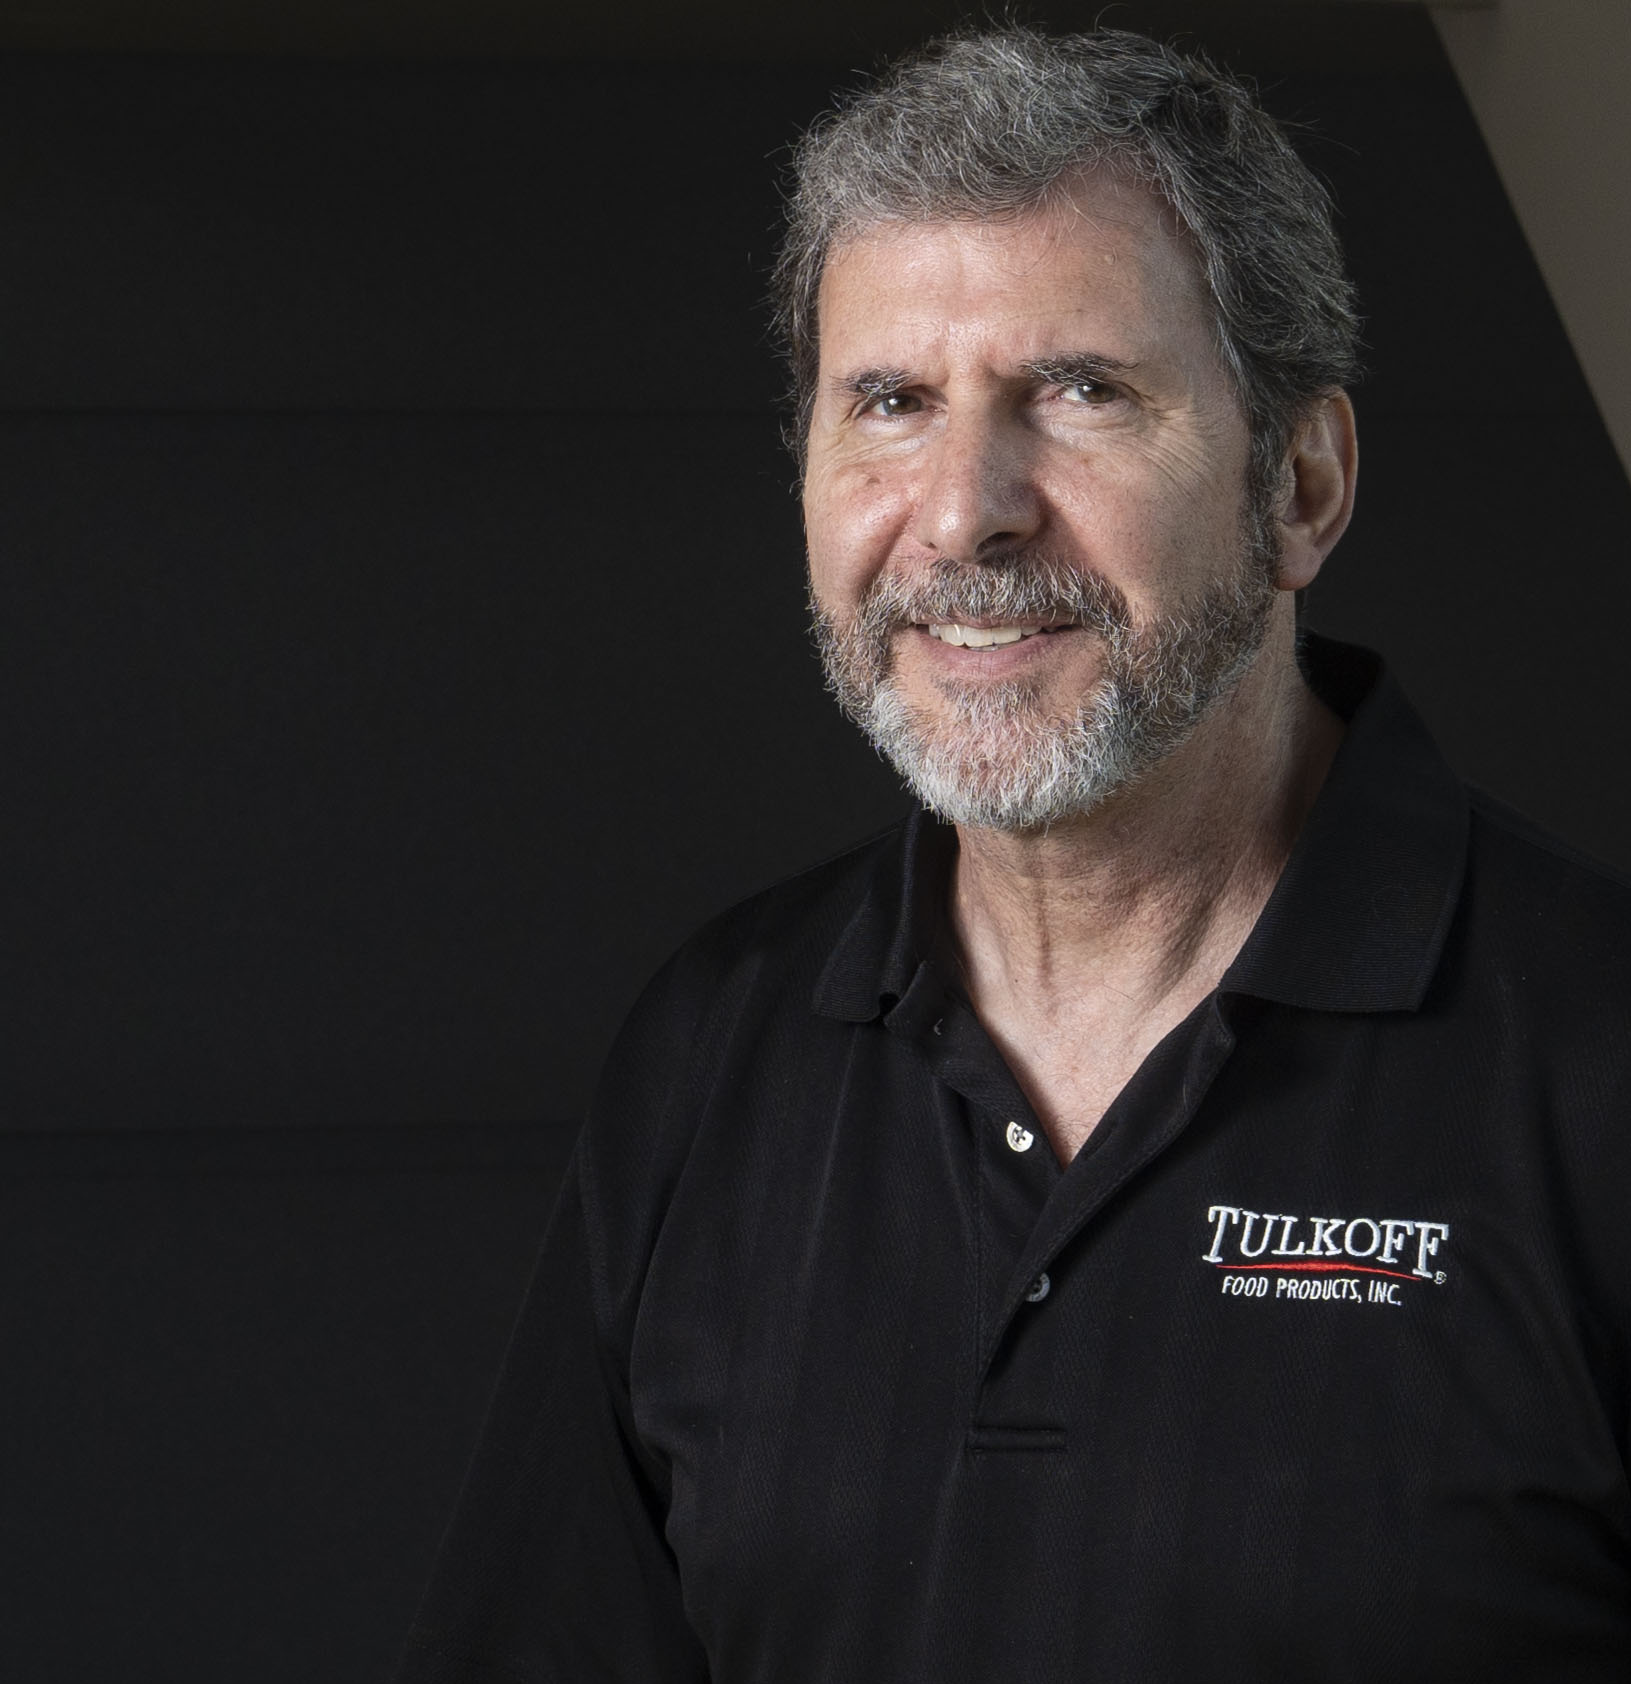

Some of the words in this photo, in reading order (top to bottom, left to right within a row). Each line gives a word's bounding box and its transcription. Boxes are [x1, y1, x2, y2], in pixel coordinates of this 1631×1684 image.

[1202, 1205, 1450, 1278] TULKOFF
[1221, 1275, 1269, 1298] FOOD
[1276, 1278, 1362, 1304] PRODUCTS,
[1367, 1280, 1402, 1306] INC.
